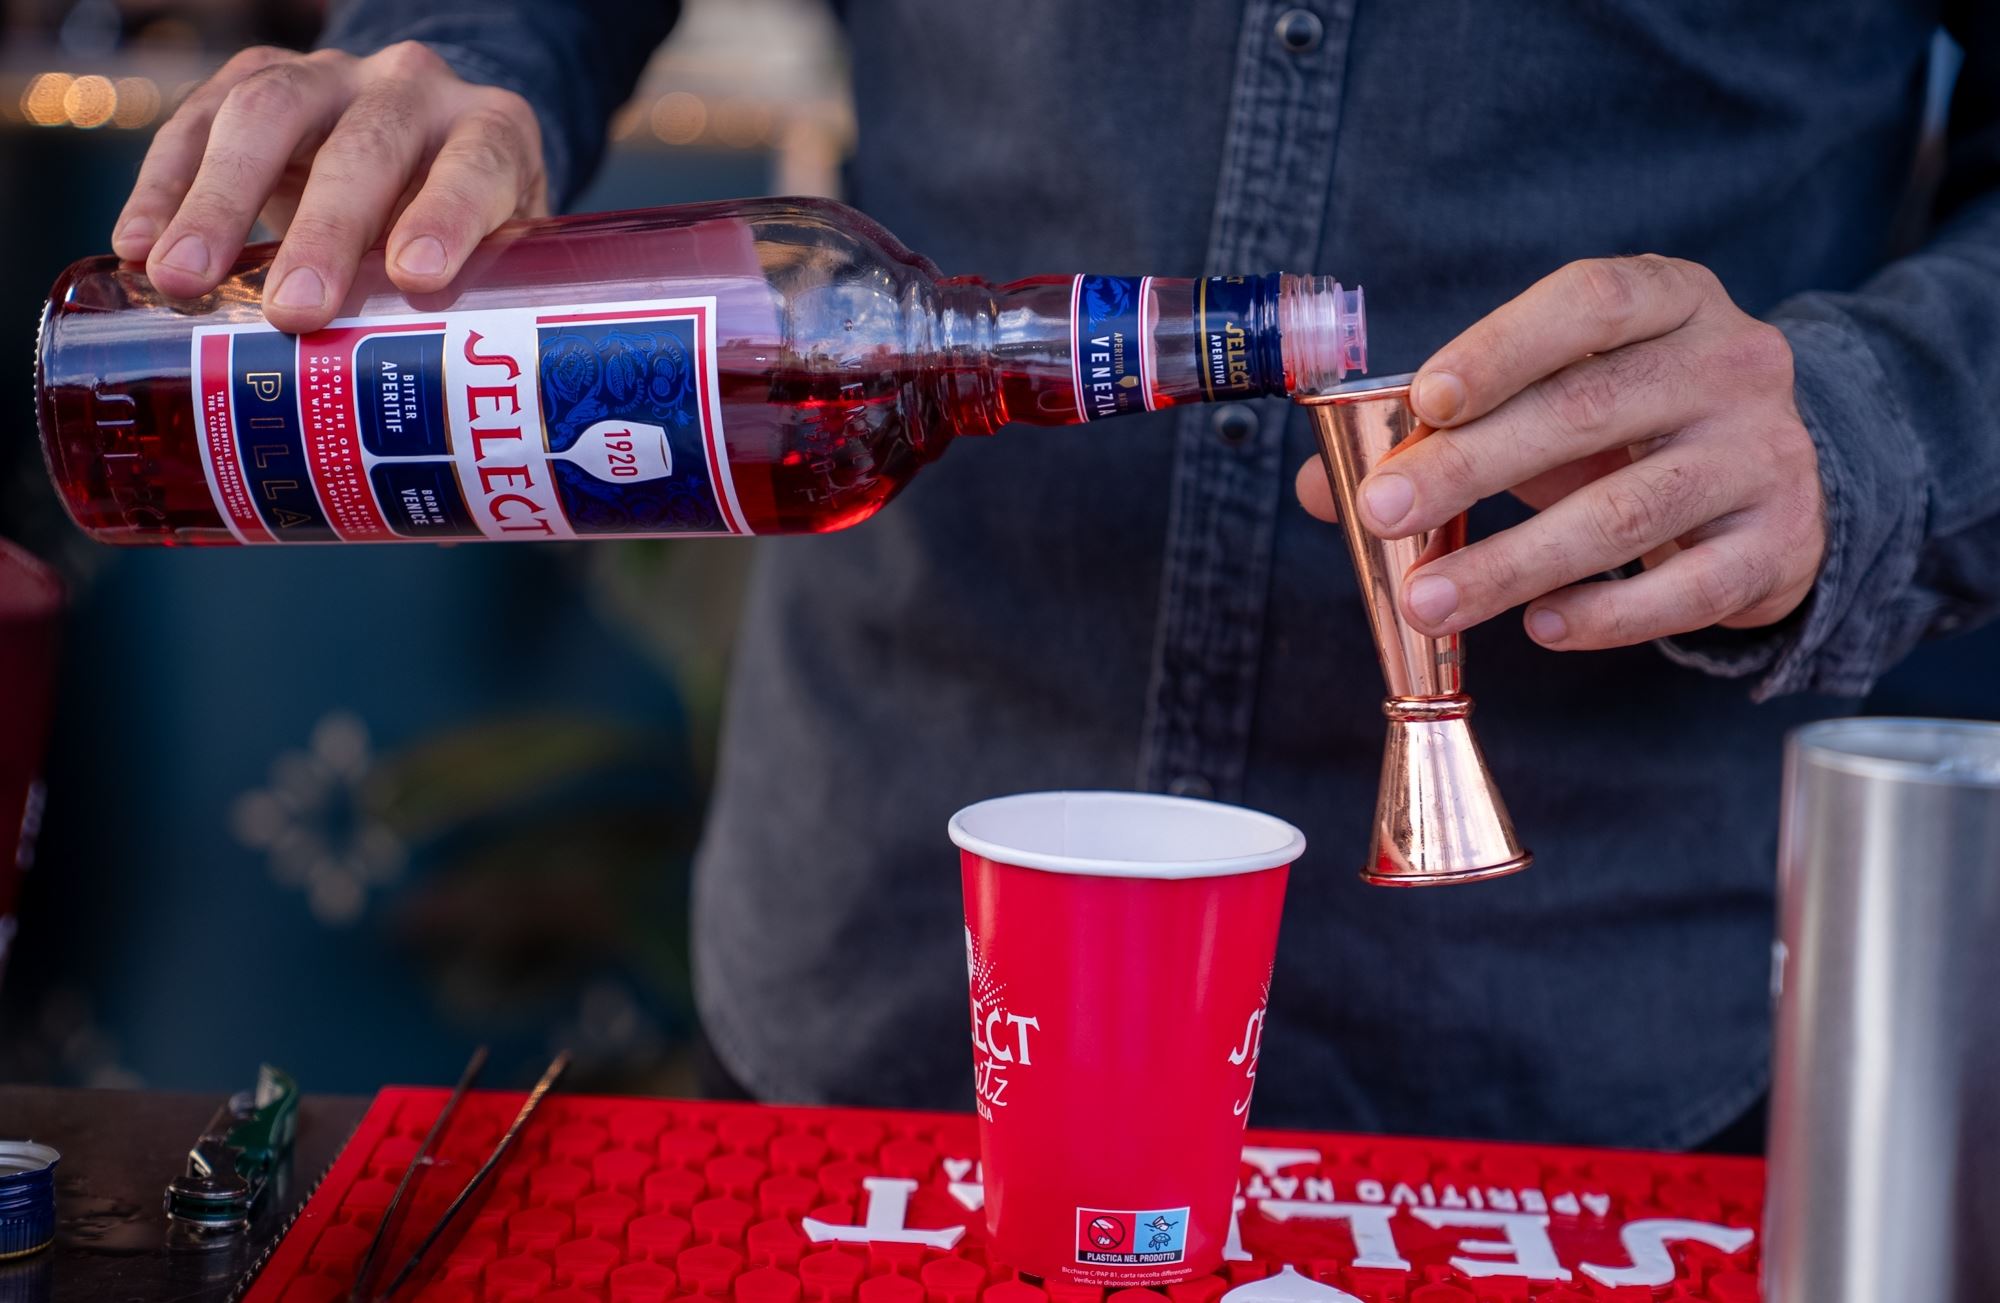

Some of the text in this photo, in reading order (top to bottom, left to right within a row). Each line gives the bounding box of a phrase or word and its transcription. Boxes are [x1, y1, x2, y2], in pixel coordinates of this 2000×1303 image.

[310, 356, 318, 390] MADE
[322, 356, 330, 374] OF
[1114, 332, 1124, 375] APERITIVO
[1210, 334, 1226, 385] APERITIVO
[1225, 321, 1250, 390] SELECT
[322, 383, 332, 408] THE
[333, 356, 342, 394] FROM
[1090, 336, 1117, 416] VENEZIA
[208, 394, 216, 412] THE
[216, 390, 225, 409] THE
[312, 398, 322, 429] WITH
[336, 404, 346, 429] THE
[382, 361, 402, 433] APERITIF
[403, 374, 417, 420] BITTER
[209, 414, 222, 452] CLASSIC
[218, 411, 231, 458] ESSENTIAL
[246, 372, 312, 528] PILLA
[325, 418, 338, 458] PILLA
[464, 329, 558, 536] SELECT
[604, 428, 638, 477] 1920
[216, 455, 232, 494] VENETIAN
[316, 436, 332, 478] THIRTY
[340, 438, 362, 499] ORIGINAL
[226, 460, 246, 506] INGREDIENT
[401, 488, 430, 525] VENICE
[422, 489, 445, 524] BORN IN
[972, 998, 1040, 1066] ECT
[974, 1056, 1008, 1107] itz
[1234, 1173, 1611, 1218] APERITIVO NAT
[1061, 1266, 1089, 1276] Bicchiere
[1090, 1270, 1109, 1278] C/PAP
[1136, 1270, 1160, 1278] raccolta
[1086, 1252, 1175, 1263] PLASTICA NEL PRODOTTO
[1074, 1276, 1096, 1285] Verifica
[1104, 1279, 1140, 1288] disposizioni
